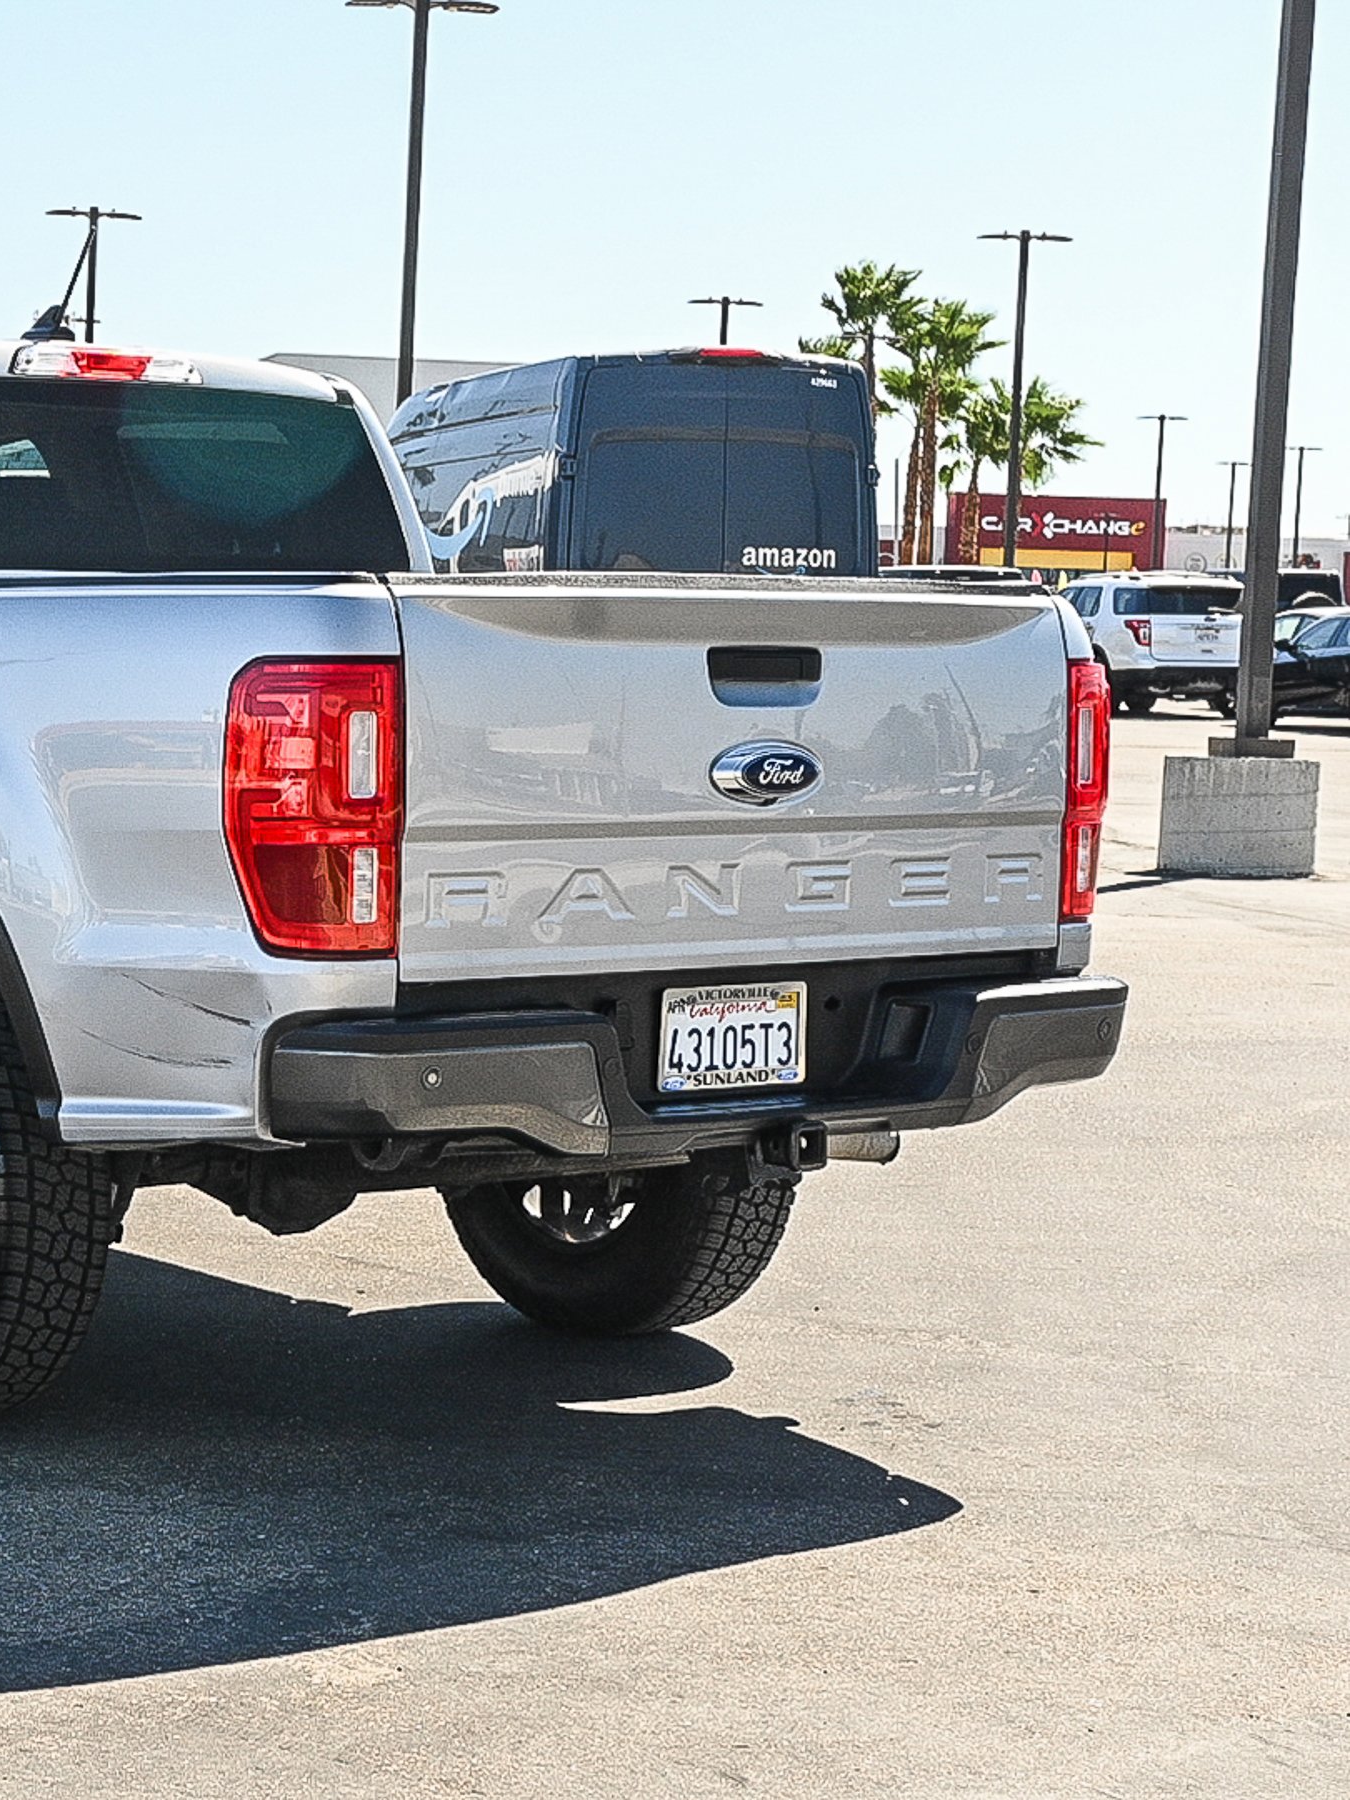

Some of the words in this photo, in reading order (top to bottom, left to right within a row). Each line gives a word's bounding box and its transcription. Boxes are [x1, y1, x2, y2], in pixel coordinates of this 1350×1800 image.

[742, 546, 836, 569] amazon
[759, 758, 804, 785] Ford
[425, 853, 1043, 929] RANGER
[698, 987, 771, 1000] VICTORVILLE
[689, 1001, 776, 1023] California
[668, 1021, 792, 1073] 43105T3
